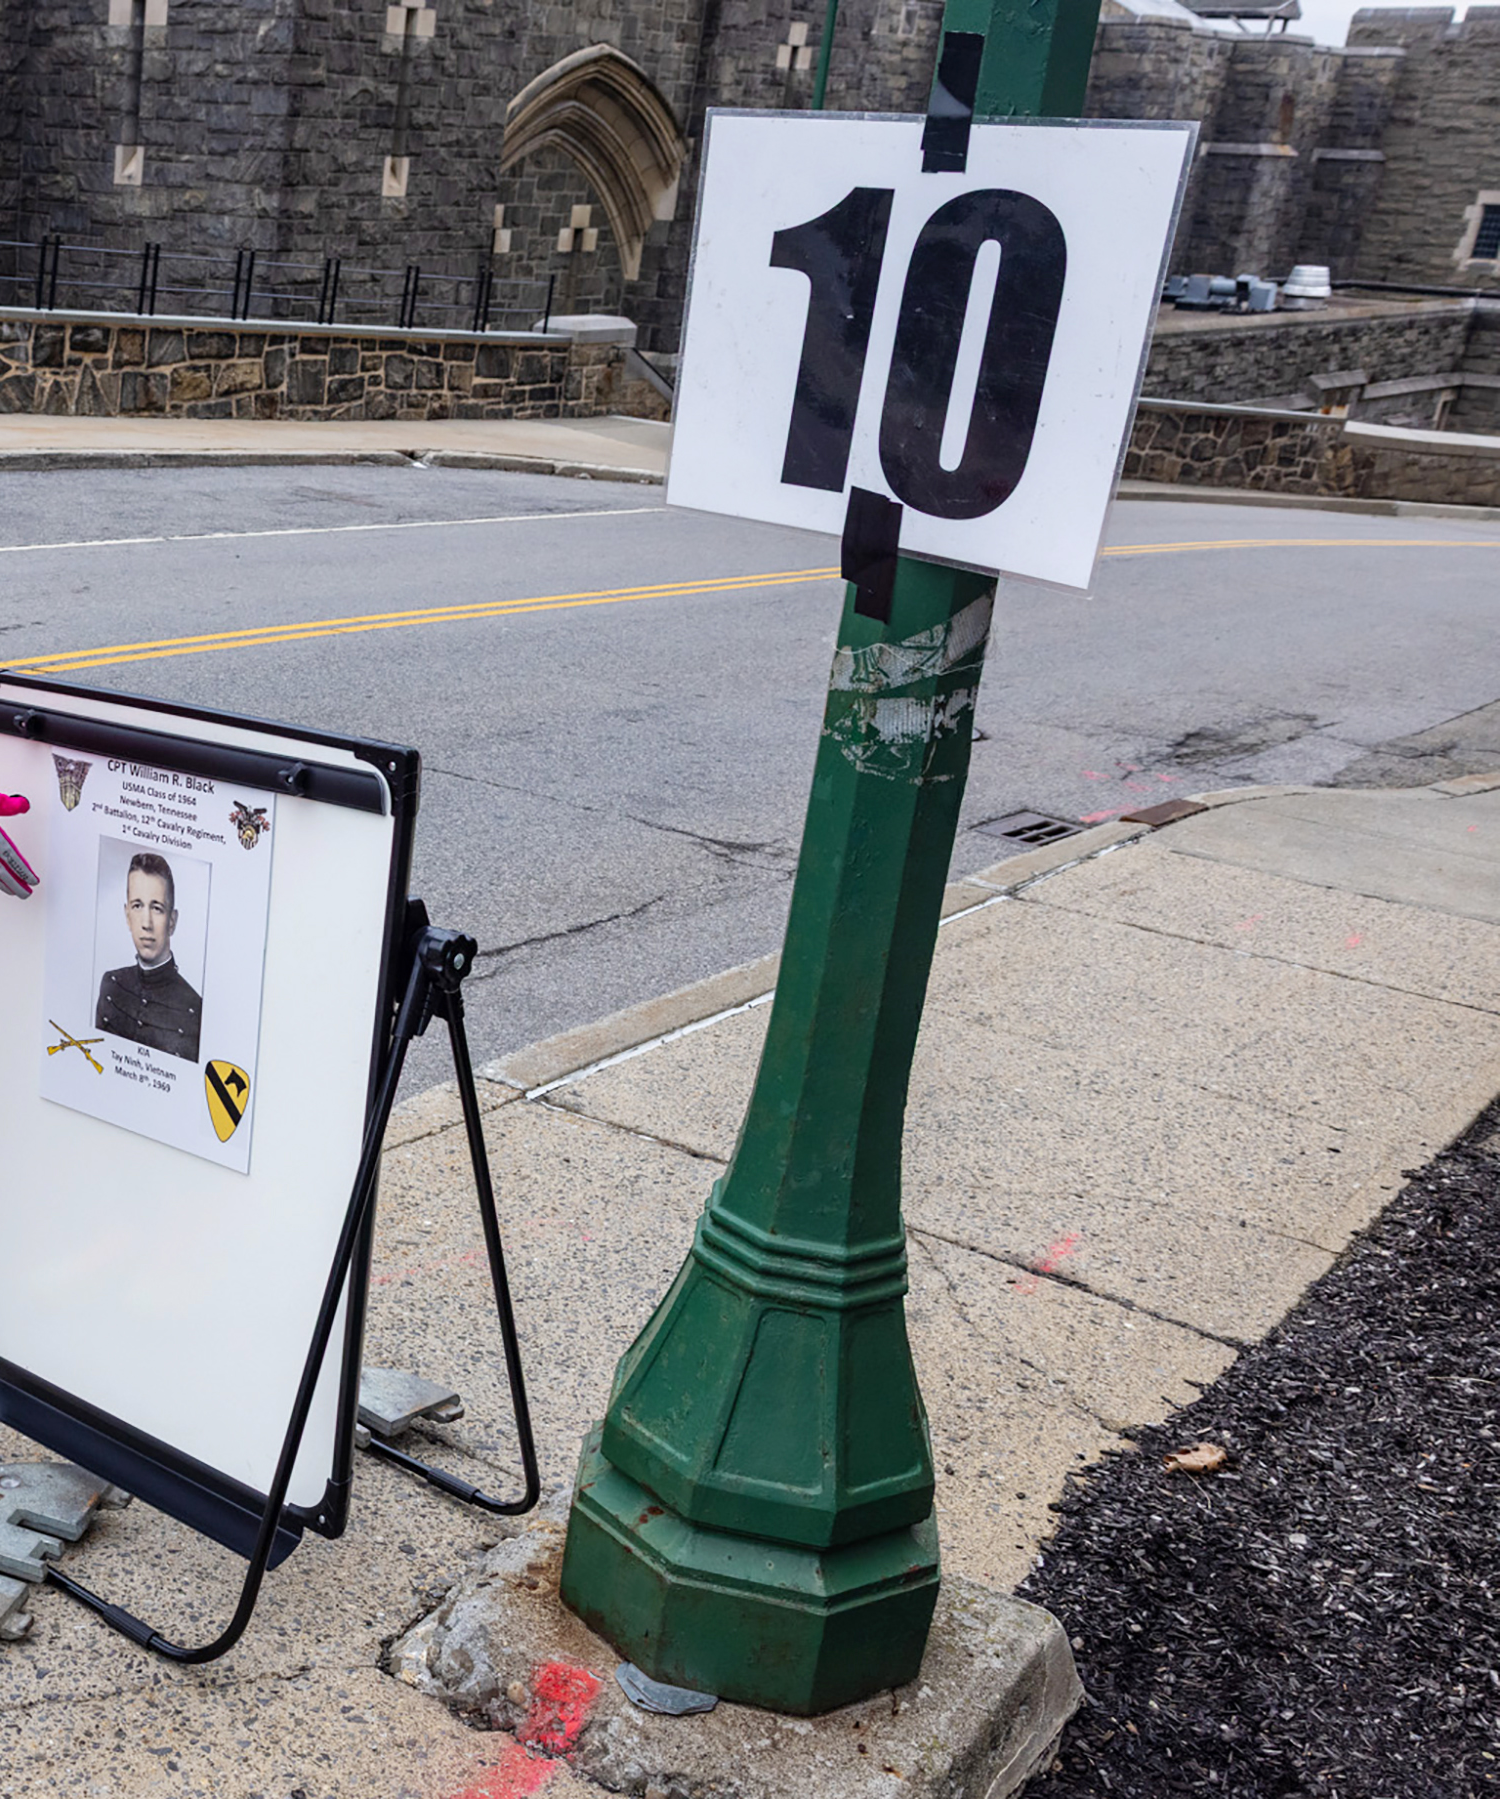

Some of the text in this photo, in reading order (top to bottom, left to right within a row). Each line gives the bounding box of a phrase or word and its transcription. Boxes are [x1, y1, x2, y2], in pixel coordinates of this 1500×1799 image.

[768, 186, 1068, 520] 10
[107, 759, 215, 794] CPT William R. Black
[122, 781, 197, 806] USMA Class of 1964
[119, 795, 198, 821] Newbern, Tennessee
[92, 802, 226, 845] 2nd Battalion, 12th Cavalry Regiment,
[122, 824, 193, 850] 1st Cavalry Division
[111, 1050, 176, 1081] Tay Ninh, Vietnam
[137, 1046, 150, 1058] KIA
[115, 1066, 137, 1081] March
[153, 1079, 171, 1093] 1969
